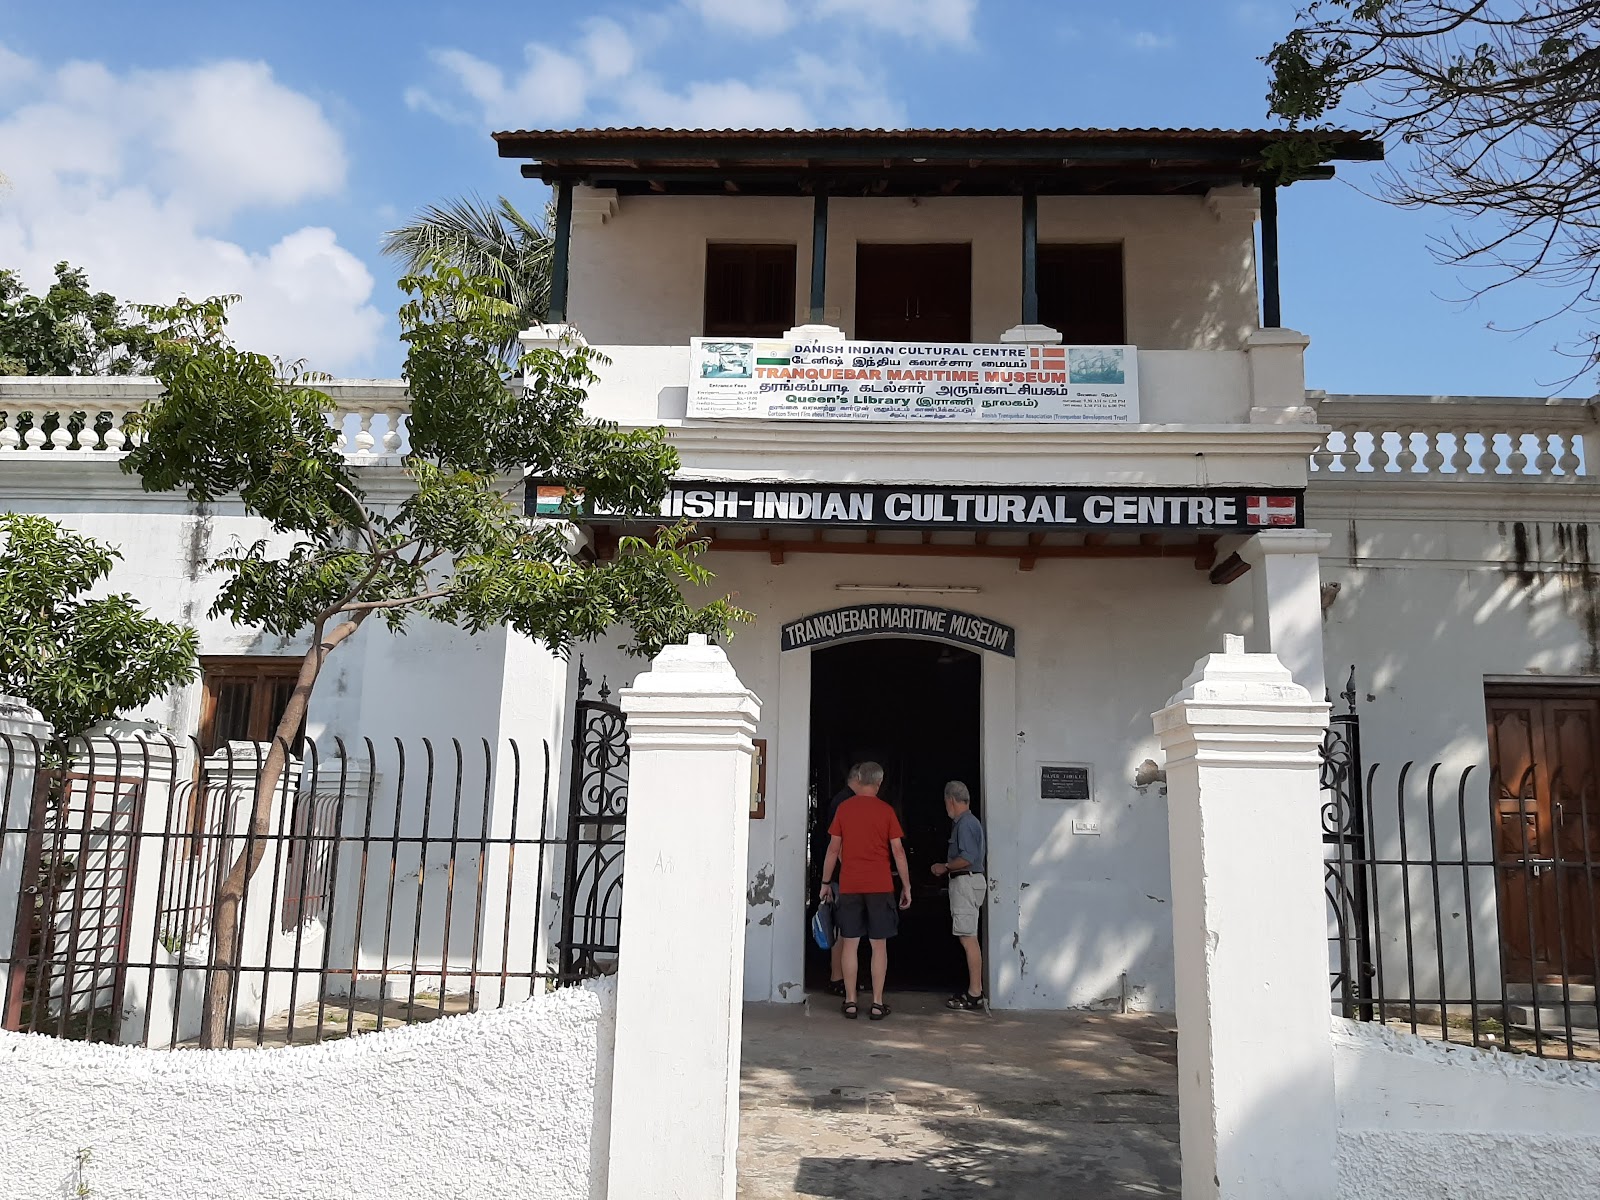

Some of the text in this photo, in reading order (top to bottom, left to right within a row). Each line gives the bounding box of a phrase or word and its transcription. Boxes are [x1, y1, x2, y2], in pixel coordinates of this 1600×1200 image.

[794, 345, 1026, 357] DANISH INDIAN CULTURAL CENTRE
[791, 356, 844, 367] டேனிஷ்
[852, 356, 901, 368] இந்திய
[908, 357, 974, 368] கலாச்சார
[755, 368, 1067, 384] TRANQUEBAR MARITIME MUSEUM
[759, 380, 1068, 398] தரங்கம்பாடி கடல்சார் அருங்காட்சியகம்
[785, 394, 911, 407] Queen's Library
[916, 397, 974, 408] (இராணி
[594, 489, 1238, 525] ISH-INDIAN CULTURAL CENTRE
[785, 607, 1010, 651] TRANQUEBAR MARITIME MUSEUM
